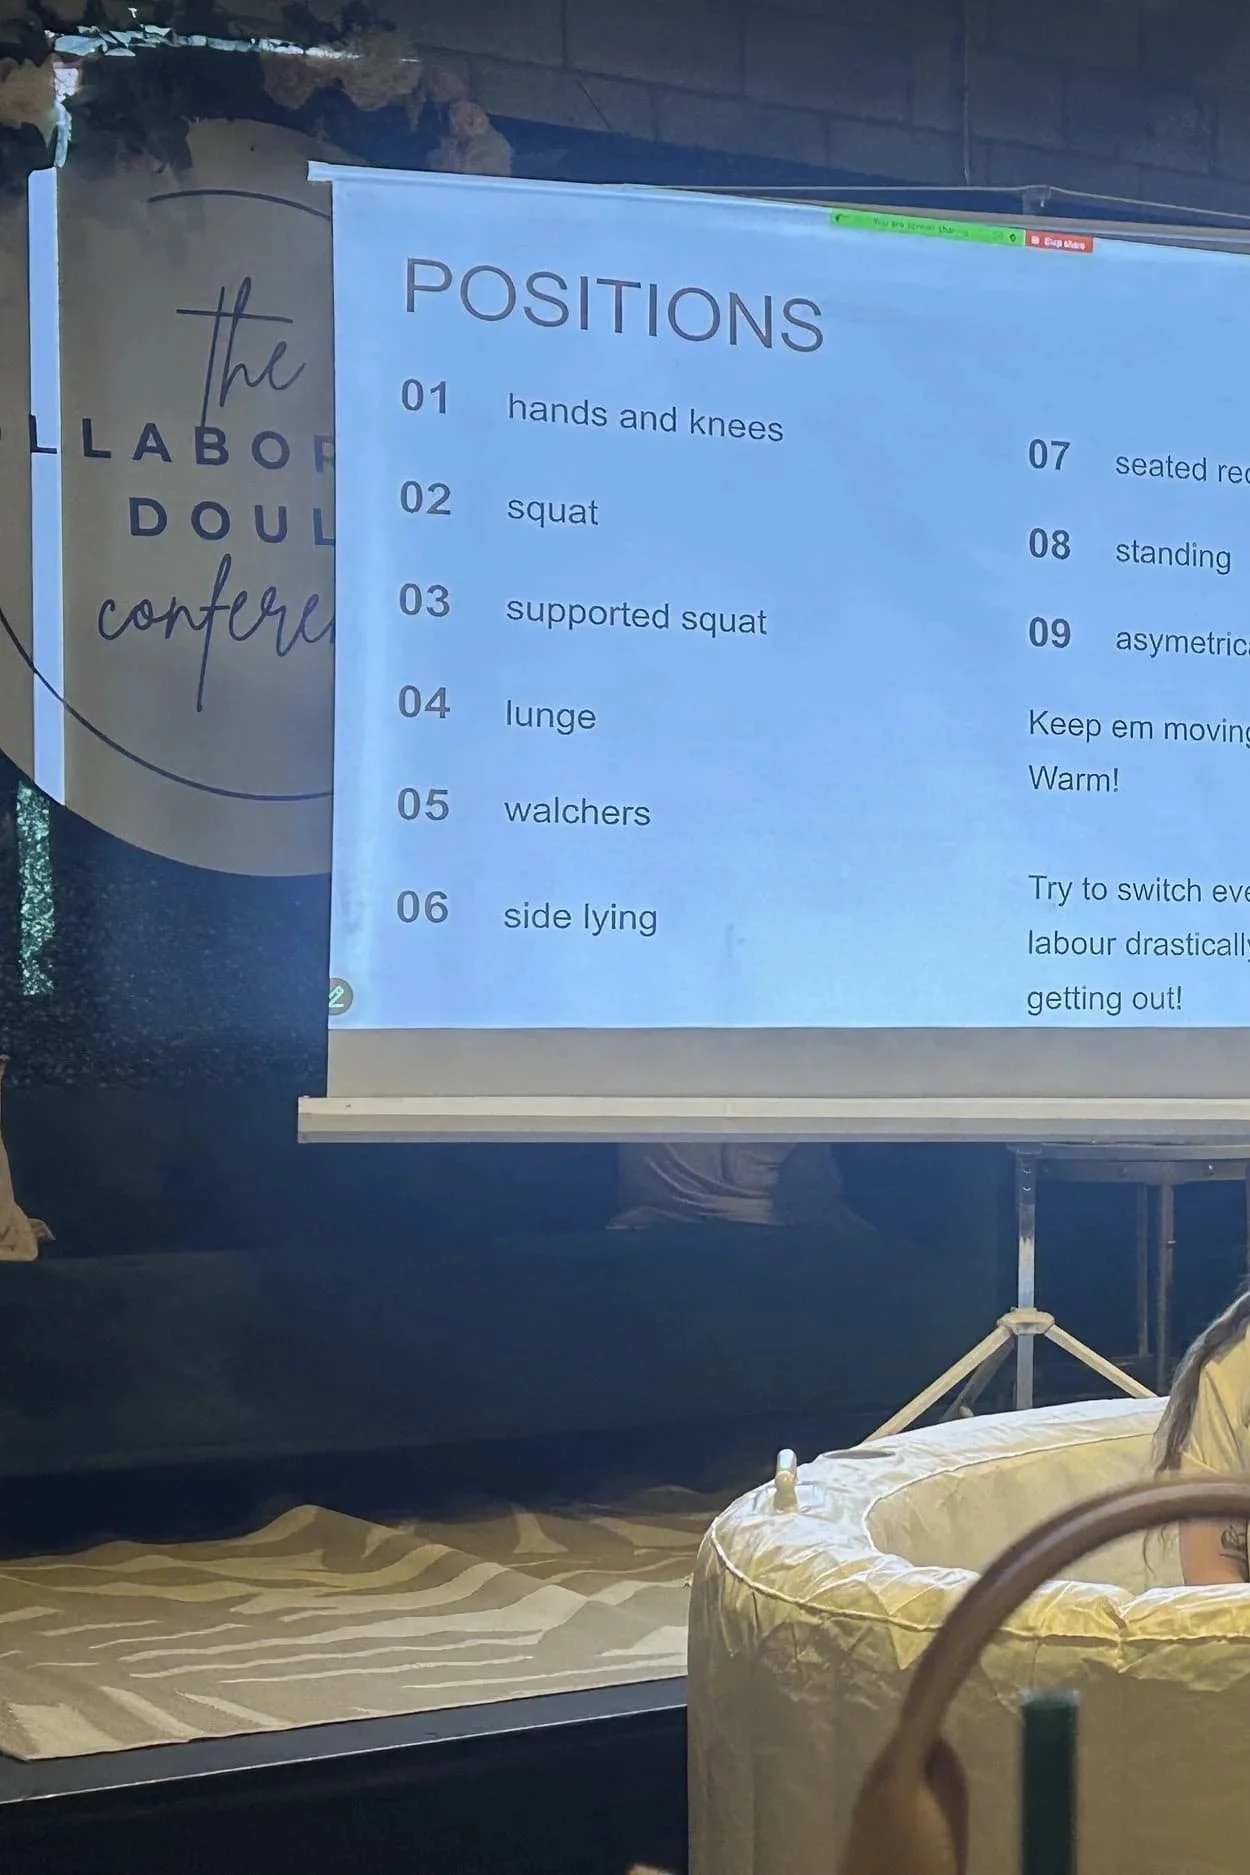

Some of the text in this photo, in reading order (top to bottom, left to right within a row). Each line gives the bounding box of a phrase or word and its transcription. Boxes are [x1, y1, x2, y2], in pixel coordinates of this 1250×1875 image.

[406, 258, 824, 353] POSITIONS
[176, 277, 306, 427] the
[401, 378, 447, 415] 01
[509, 392, 784, 443] hands and knees
[0, 414, 335, 473] LLABOR
[1028, 438, 1071, 471] 07
[1115, 454, 1207, 482] seated
[400, 480, 452, 516] 02
[507, 499, 599, 529] squat
[1029, 527, 1071, 561] 08
[1115, 539, 1231, 576] standing
[399, 582, 450, 618] 03
[98, 553, 335, 712] confere
[506, 600, 768, 639] supported squat
[1028, 616, 1071, 649] 09
[398, 684, 451, 719] 04
[506, 699, 597, 736] lunge
[1029, 708, 1102, 744] Keep
[1111, 719, 1153, 741] em
[1028, 764, 1119, 793] Warm!
[397, 787, 450, 822] 05
[503, 796, 651, 827] walchers
[397, 890, 449, 924] 06
[1027, 874, 1073, 907] Try
[1081, 876, 1108, 901] to
[1117, 876, 1202, 903] switch
[503, 901, 657, 938] side lying
[1028, 929, 1118, 956] labour
[1026, 984, 1182, 1017] getting out!
